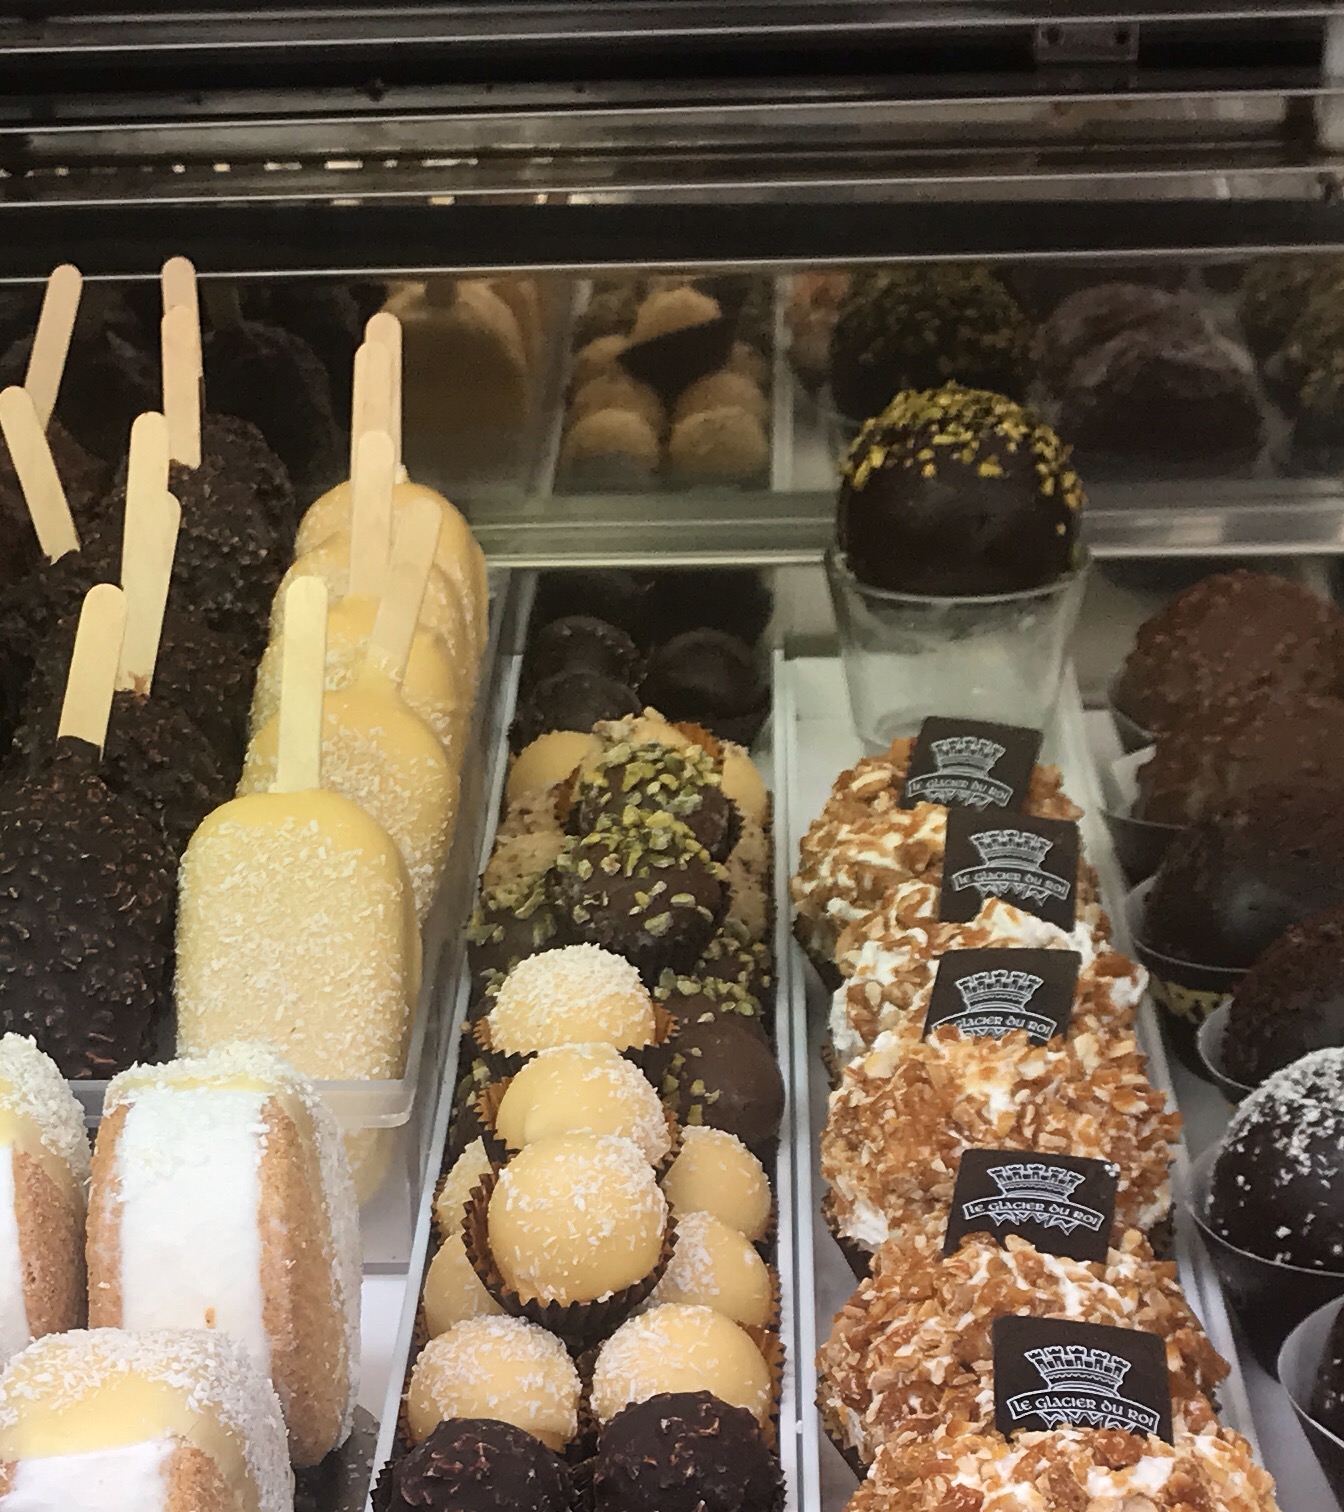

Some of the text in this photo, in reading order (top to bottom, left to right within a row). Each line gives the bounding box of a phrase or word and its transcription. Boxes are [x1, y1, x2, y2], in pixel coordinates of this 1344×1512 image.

[988, 1200, 1045, 1212] GLACIER
[1048, 1205, 1071, 1217] DU
[1073, 1210, 1098, 1226] ROI
[1035, 1395, 1097, 1410] GLACIER
[1100, 1399, 1124, 1416] DU
[1127, 1407, 1155, 1427] ROI
